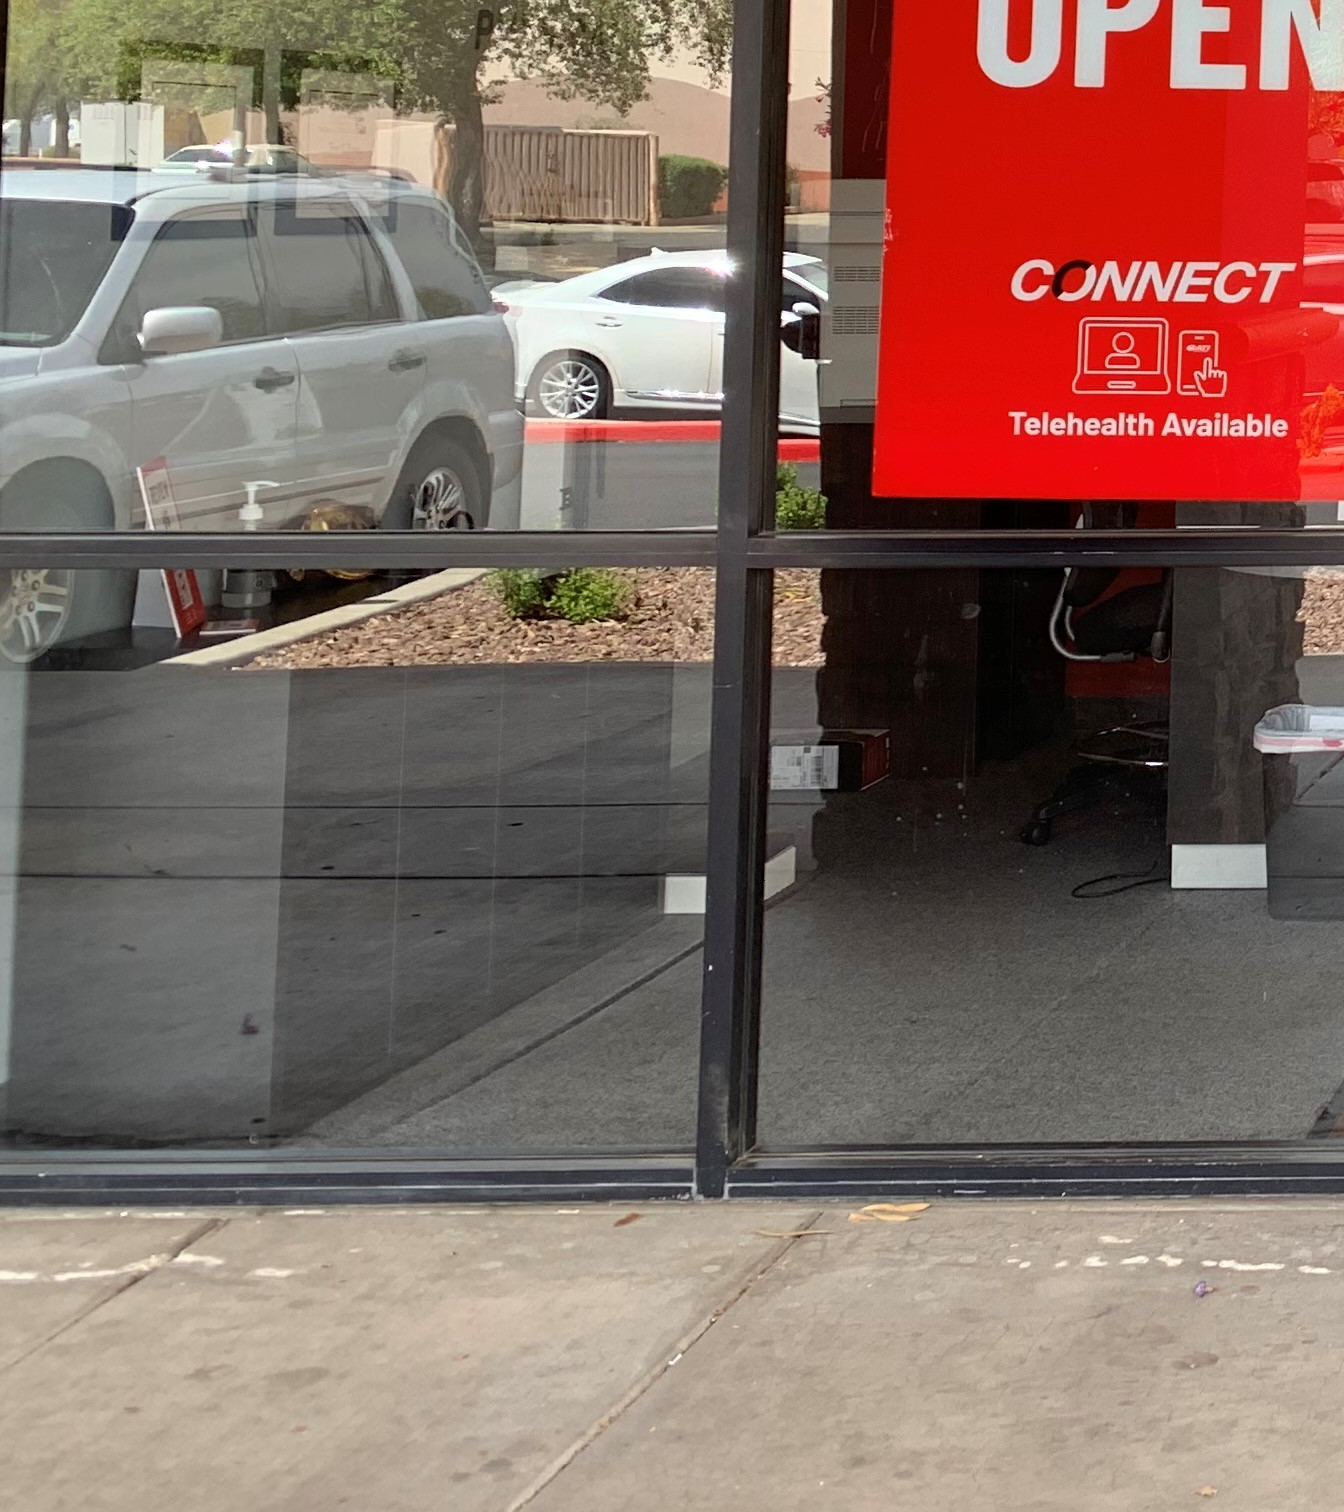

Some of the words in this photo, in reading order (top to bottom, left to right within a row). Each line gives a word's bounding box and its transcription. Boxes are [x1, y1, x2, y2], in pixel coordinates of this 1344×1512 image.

[1010, 259, 1296, 305] CONNECT
[1009, 411, 1154, 439] Telehealth
[1161, 411, 1289, 439] Available
